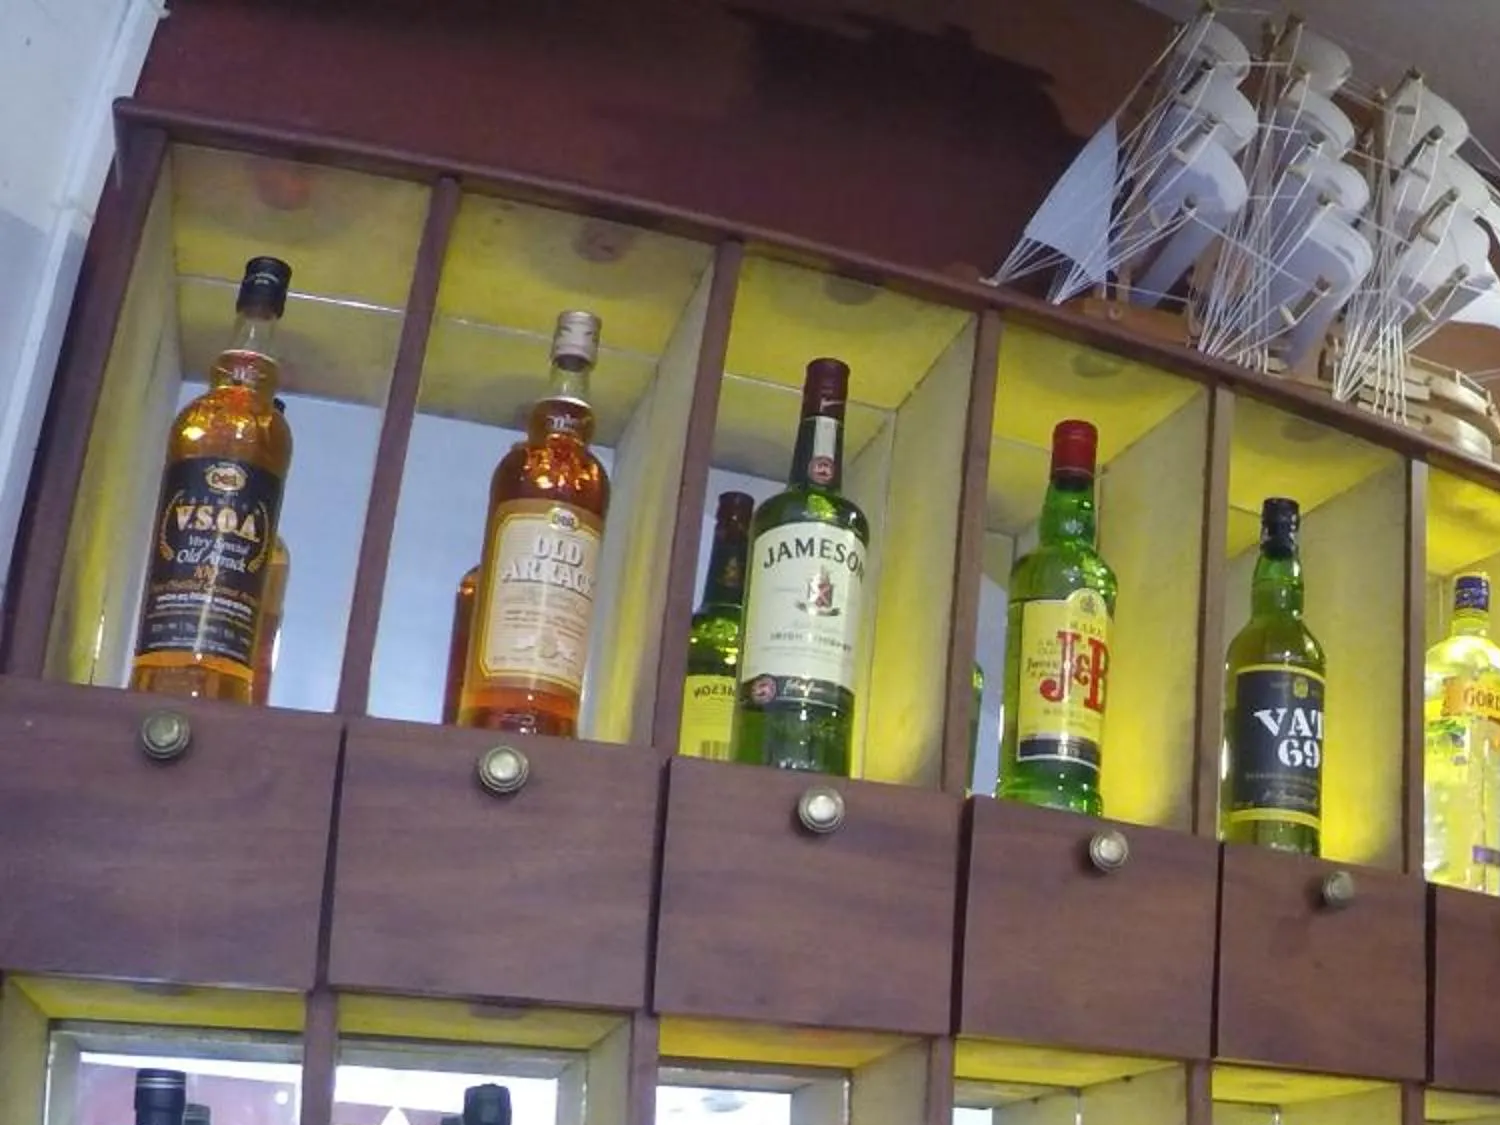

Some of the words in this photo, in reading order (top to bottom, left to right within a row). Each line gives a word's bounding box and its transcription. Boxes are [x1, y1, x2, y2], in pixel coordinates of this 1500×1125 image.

[532, 535, 583, 568] OLD
[763, 537, 866, 584] JAMESON
[1040, 629, 1110, 714] J&B
[1278, 738, 1321, 769] 69
